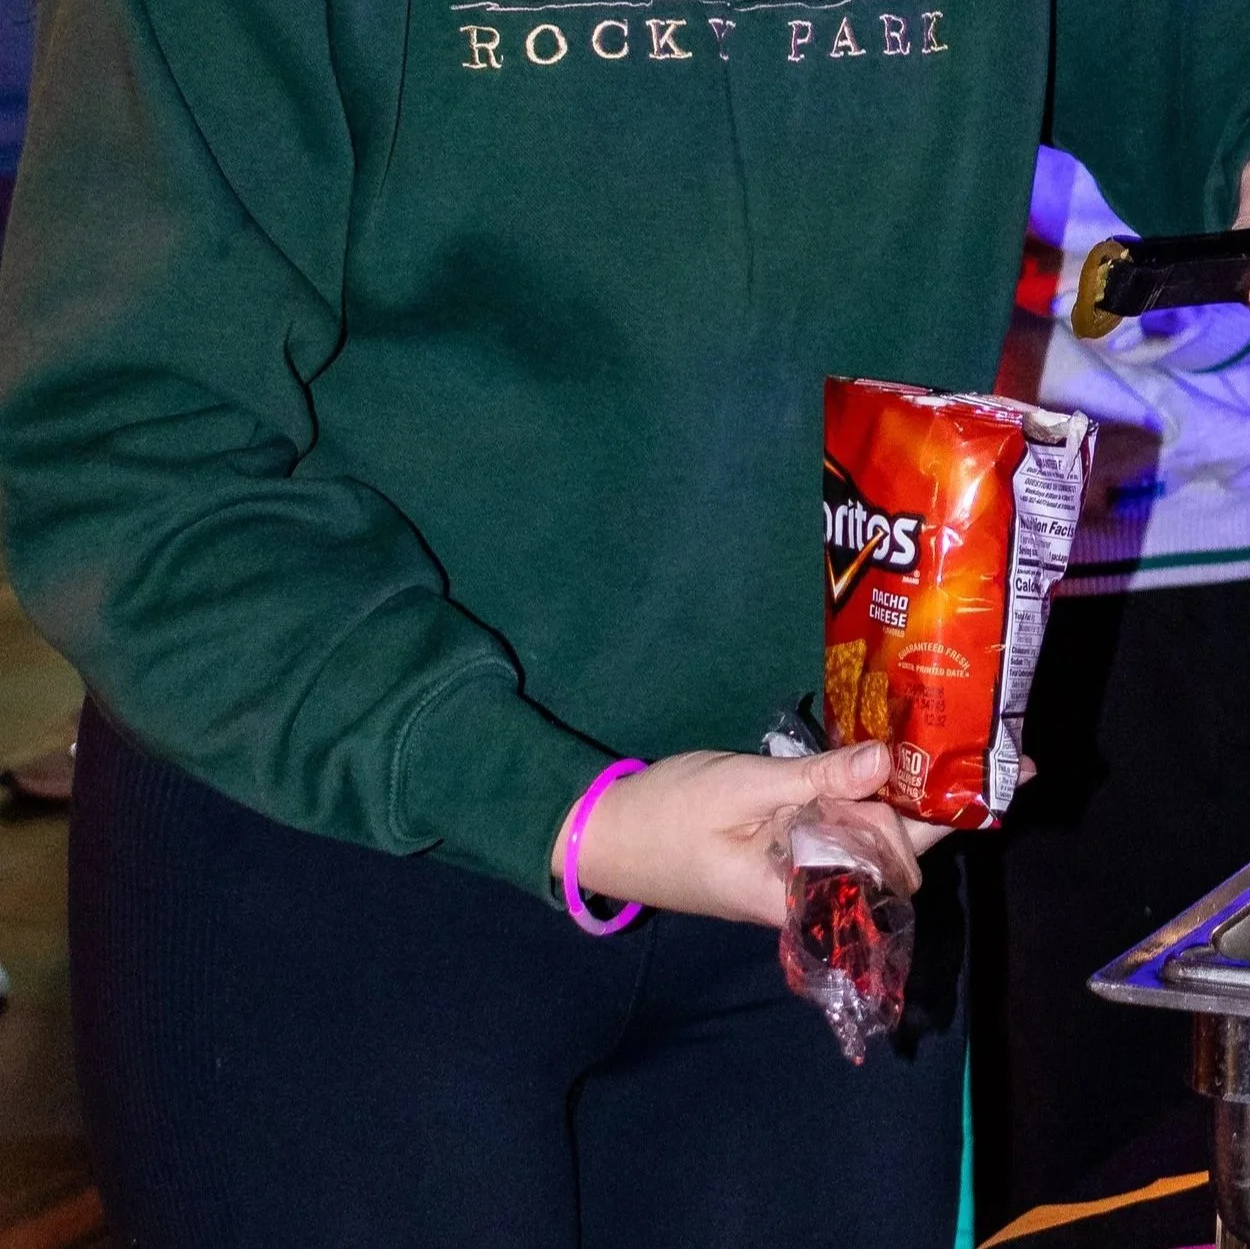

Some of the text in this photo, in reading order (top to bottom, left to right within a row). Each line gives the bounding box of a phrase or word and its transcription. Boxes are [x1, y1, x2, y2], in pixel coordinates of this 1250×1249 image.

[459, 11, 949, 69] ROCKY PARK
[1048, 521, 1076, 538] Facts
[872, 588, 909, 611] NACHO
[869, 603, 908, 628] CHEESE
[898, 642, 971, 671] GUARANTEED FRESH
[915, 664, 945, 677] PRINTED
[946, 668, 964, 678] DATE
